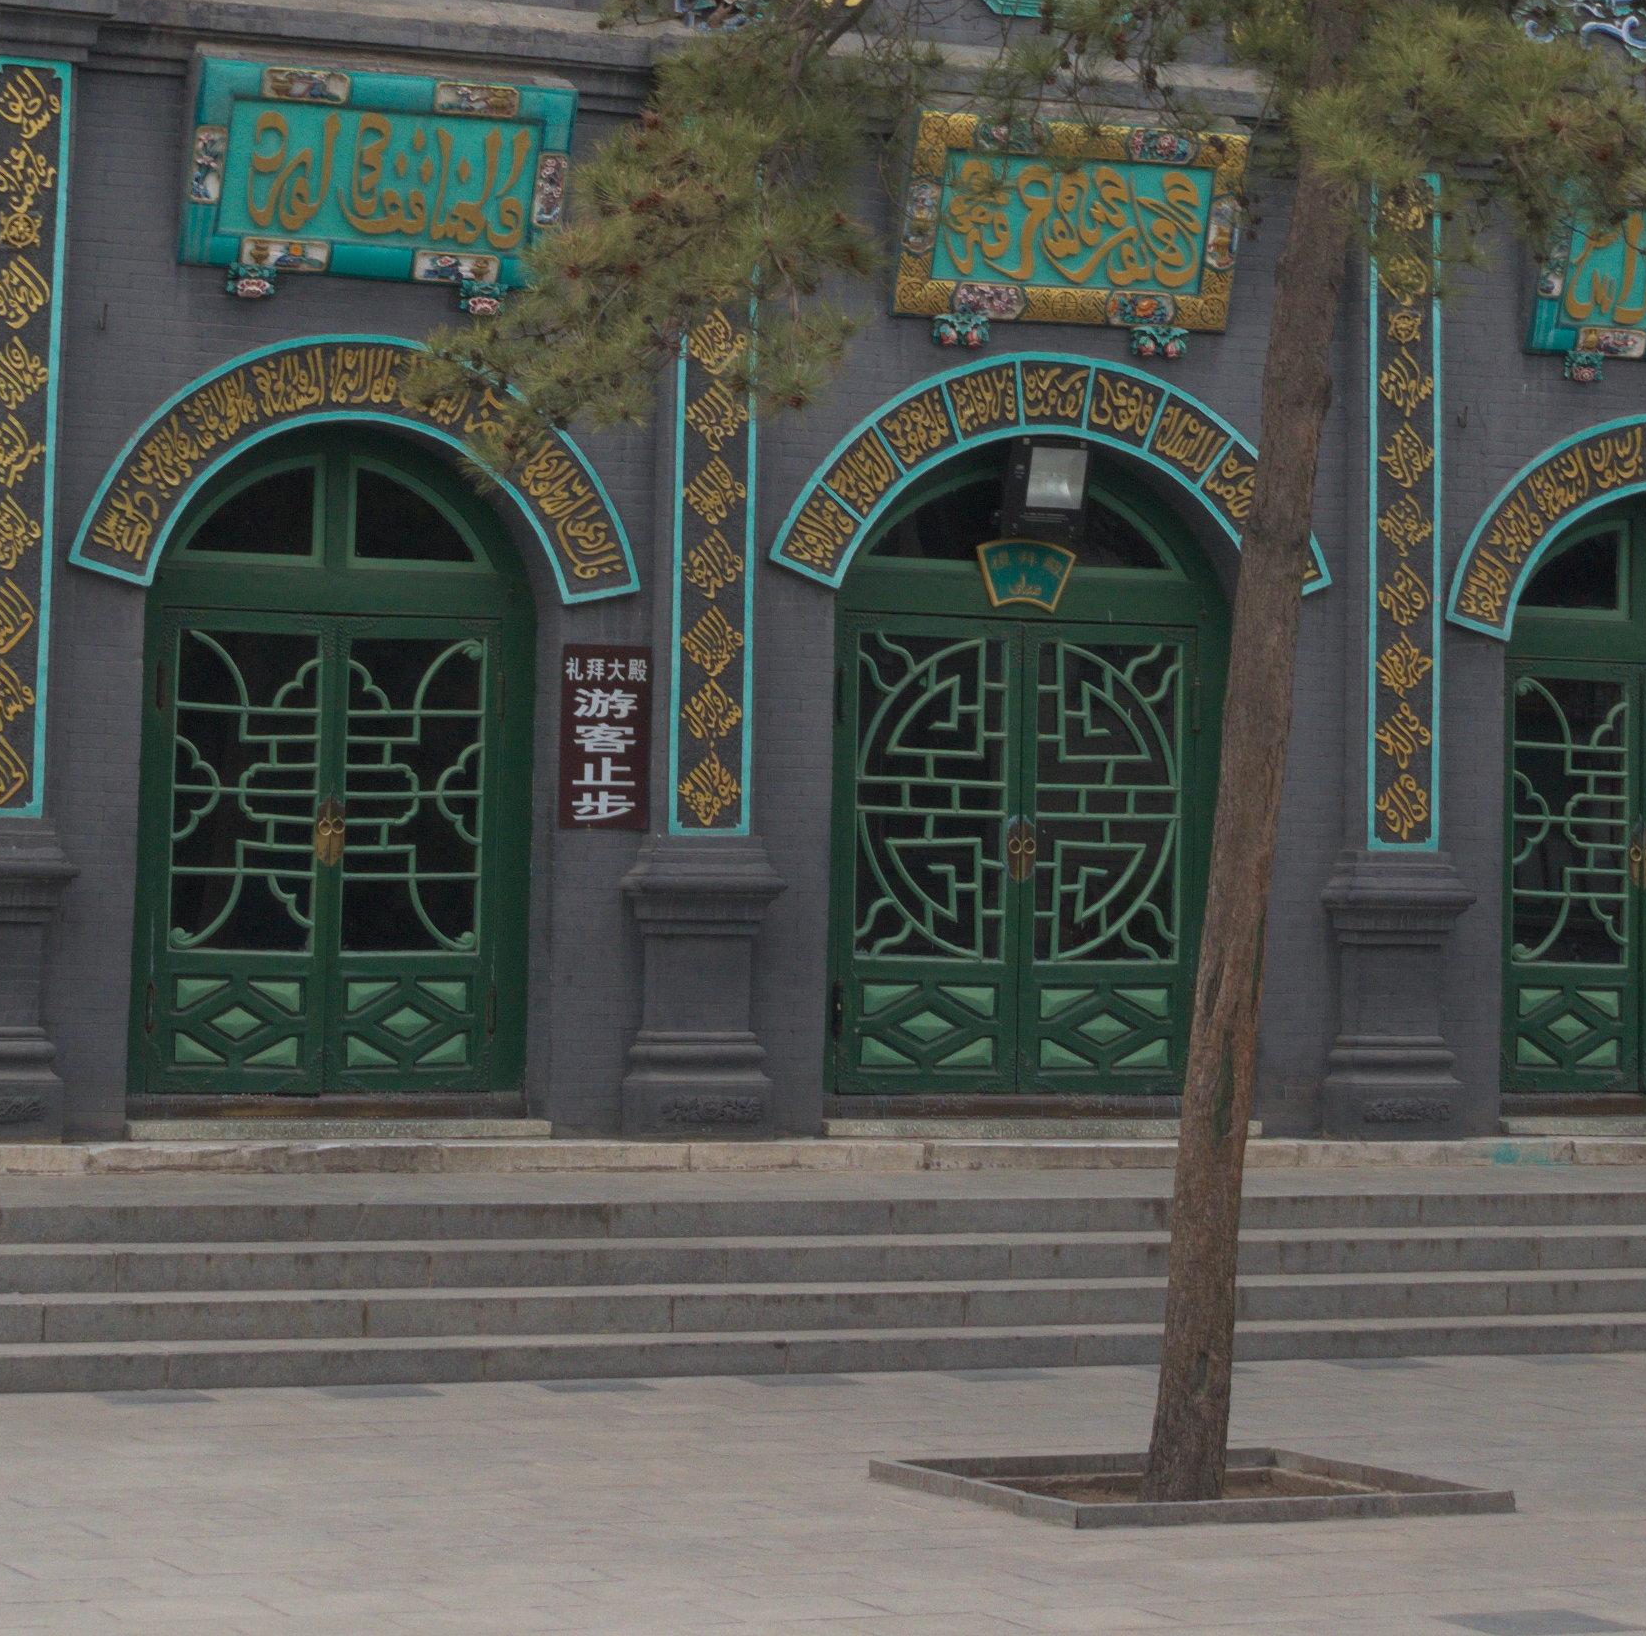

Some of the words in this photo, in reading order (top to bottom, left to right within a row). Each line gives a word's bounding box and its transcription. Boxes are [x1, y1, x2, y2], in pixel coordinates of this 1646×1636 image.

[565, 657, 647, 682] 礼拜大殿
[572, 688, 638, 820] 游客止步
